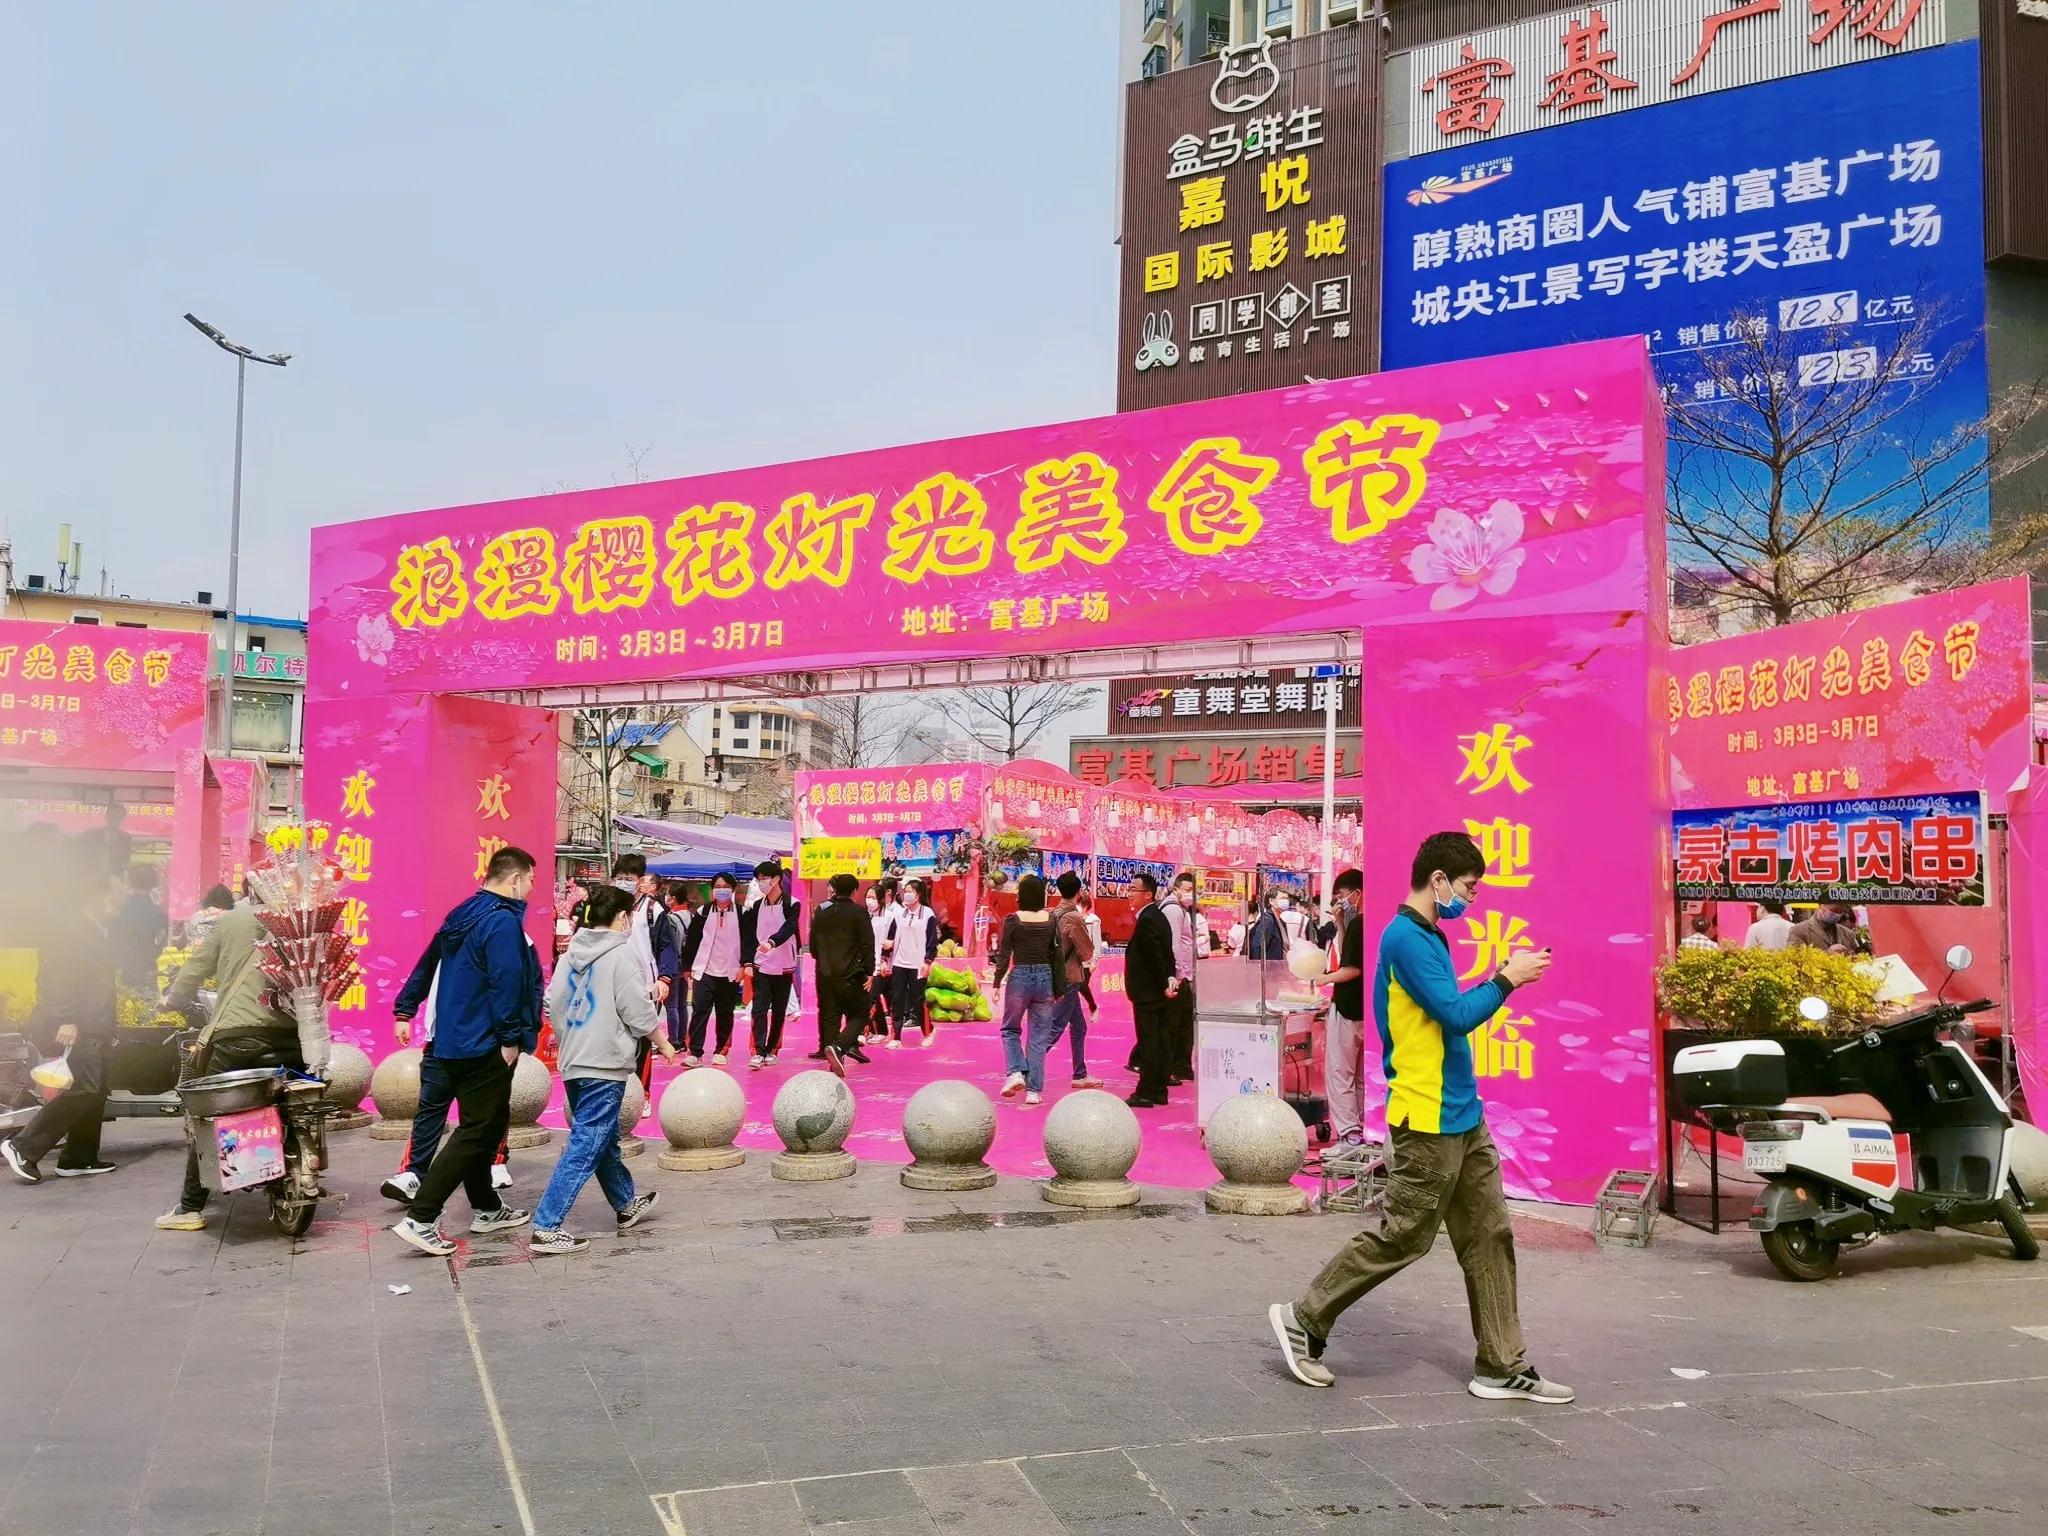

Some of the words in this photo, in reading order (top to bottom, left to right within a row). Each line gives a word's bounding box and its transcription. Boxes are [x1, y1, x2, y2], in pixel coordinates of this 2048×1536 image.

[1167, 105, 1325, 180] 盒马鲜生
[1179, 155, 1312, 233] 嘉悦
[1413, 139, 1942, 271] 醇熟商圈人气铺富基广场
[1144, 214, 1347, 294] 国际影城
[1412, 204, 1943, 327] 城央江景写字楼天盈广场
[1189, 320, 1351, 363] 教育生活广场
[1863, 294, 1915, 320] 亿元
[391, 413, 1441, 628] 浪漫樱花灯光美食节
[1677, 814, 1979, 885] 蒙古烤肉串
[1456, 722, 1535, 1079] 欢迎光临
